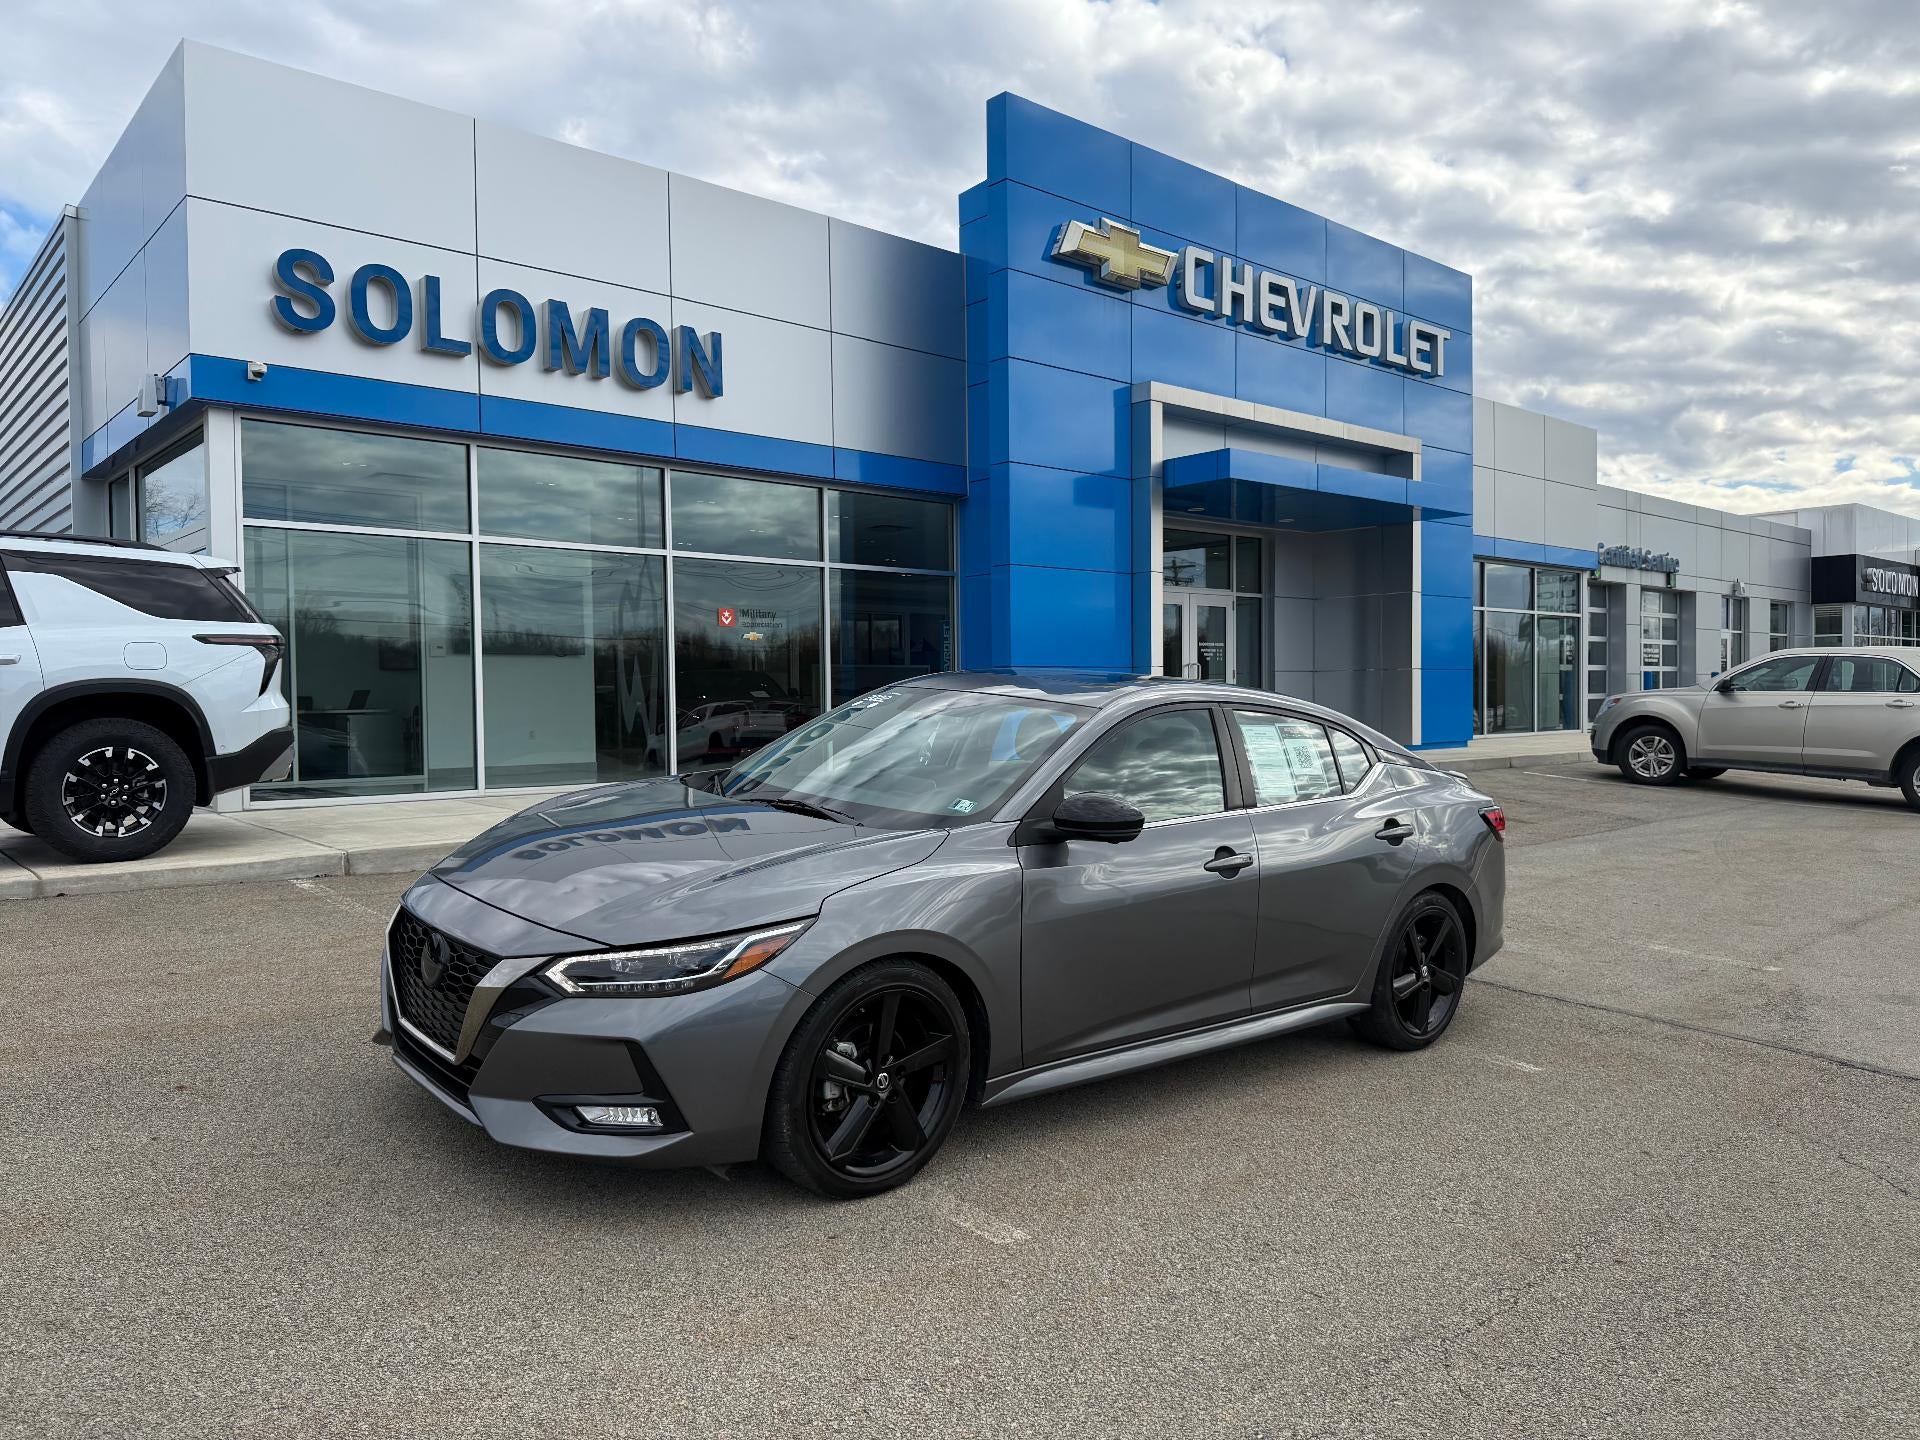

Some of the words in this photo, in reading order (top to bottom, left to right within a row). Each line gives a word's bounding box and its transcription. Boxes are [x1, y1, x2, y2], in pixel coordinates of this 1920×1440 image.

[270, 248, 724, 398] SOLOMON
[1178, 245, 1451, 378] CHEVROLET
[1597, 542, 1643, 569] Certified
[1644, 549, 1680, 573] Service
[1867, 567, 1919, 598] SOLOMON
[740, 608, 777, 621] Military
